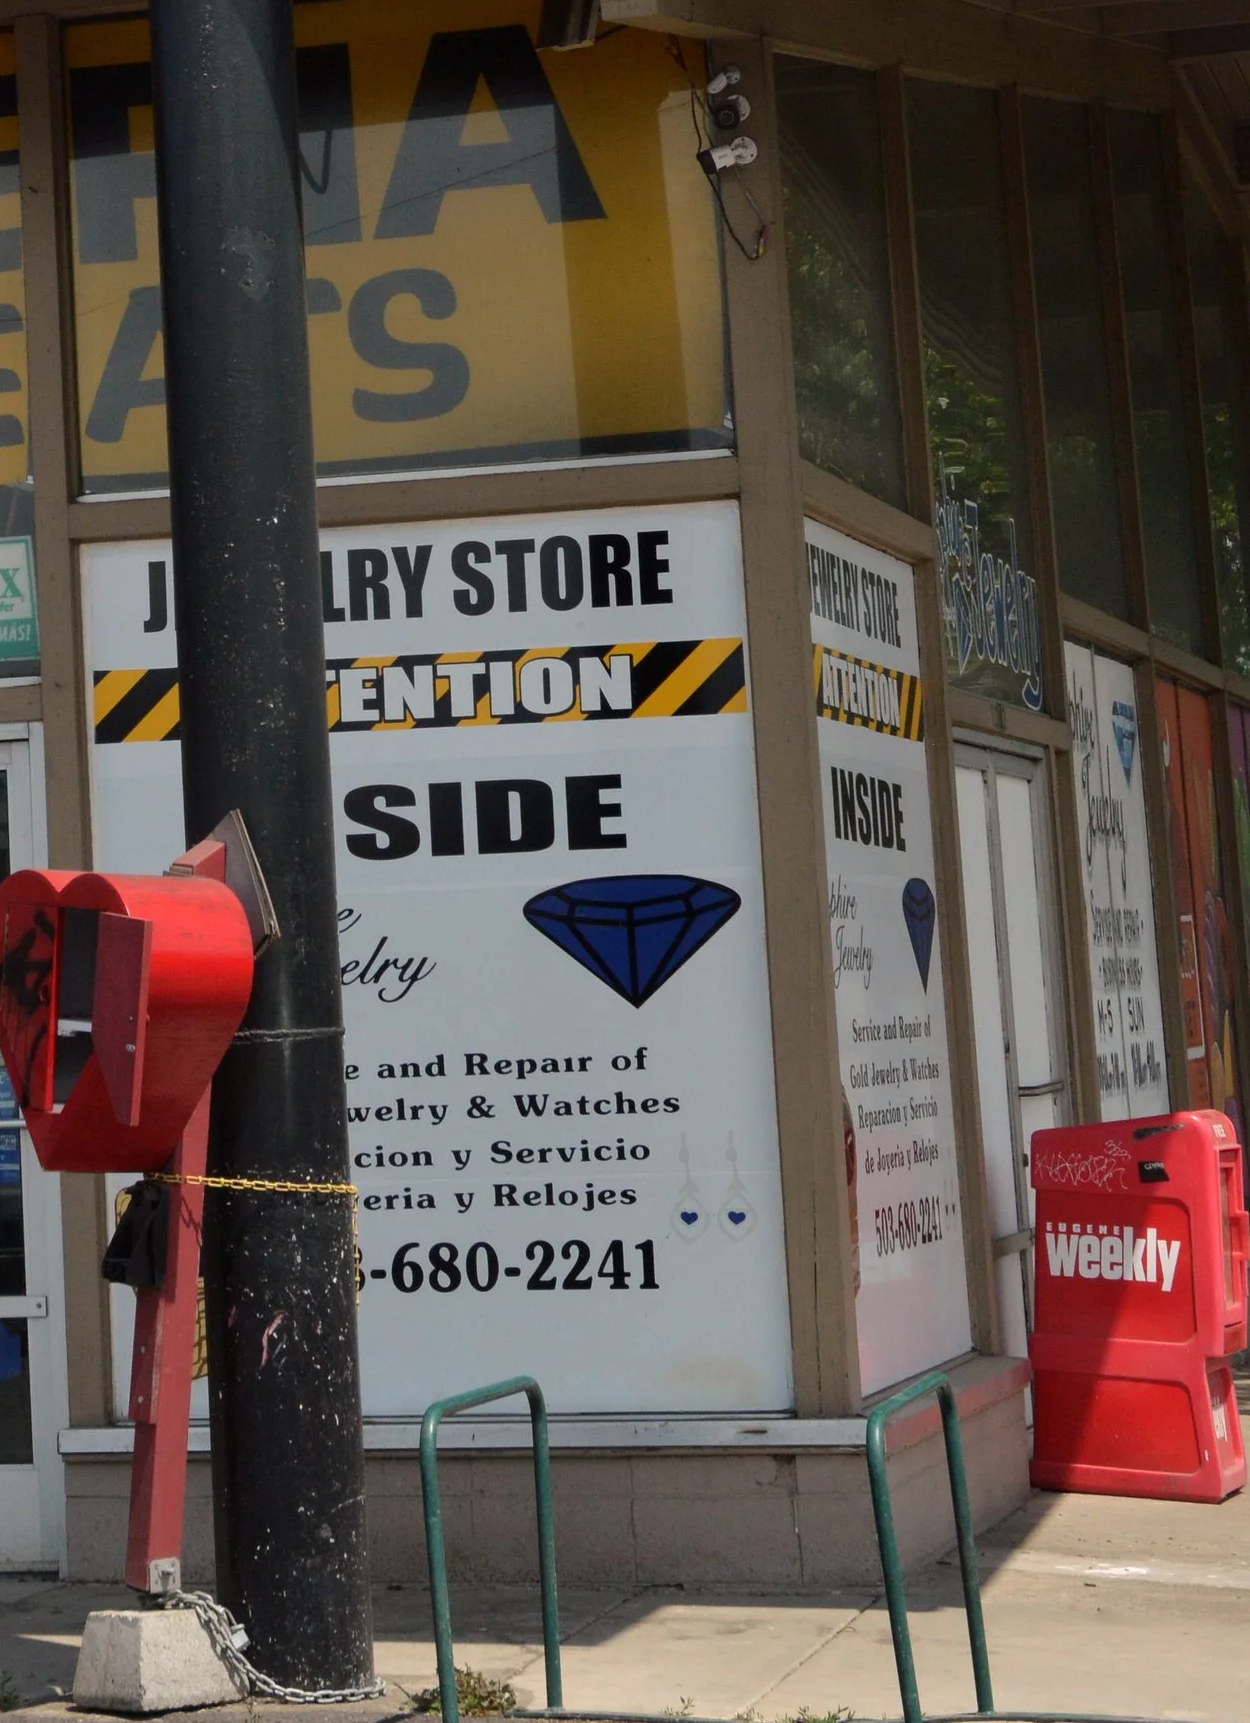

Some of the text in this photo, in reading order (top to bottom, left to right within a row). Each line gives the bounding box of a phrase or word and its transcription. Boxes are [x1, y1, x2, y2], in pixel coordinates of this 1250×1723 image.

[451, 530, 673, 617] STORE
[861, 567, 901, 649] STORE
[821, 652, 900, 728] ATTENTION
[344, 774, 627, 860] SIDE
[830, 766, 906, 853] INSIDE
[834, 924, 874, 990] Jewelry
[852, 1013, 932, 1044] Service and Repair of
[377, 1054, 446, 1079] and
[464, 1051, 594, 1081] Repair
[611, 1047, 649, 1072] of
[850, 1064, 869, 1089] Gold
[871, 1060, 901, 1089] Jewelry
[909, 1056, 940, 1081] Watches
[467, 1095, 496, 1119] &
[515, 1091, 681, 1118] Watches
[858, 1095, 938, 1133] Reparacion y Servicio
[451, 1149, 472, 1171] y
[489, 1140, 651, 1165] Servicio
[865, 1138, 939, 1176] de Joyeria y Relojes
[454, 1192, 474, 1213] y
[493, 1184, 638, 1214] Relojes
[875, 1195, 943, 1258] 503-680-2241
[1046, 1222, 1120, 1236] EUGENE
[1045, 1225, 1182, 1293] weekly
